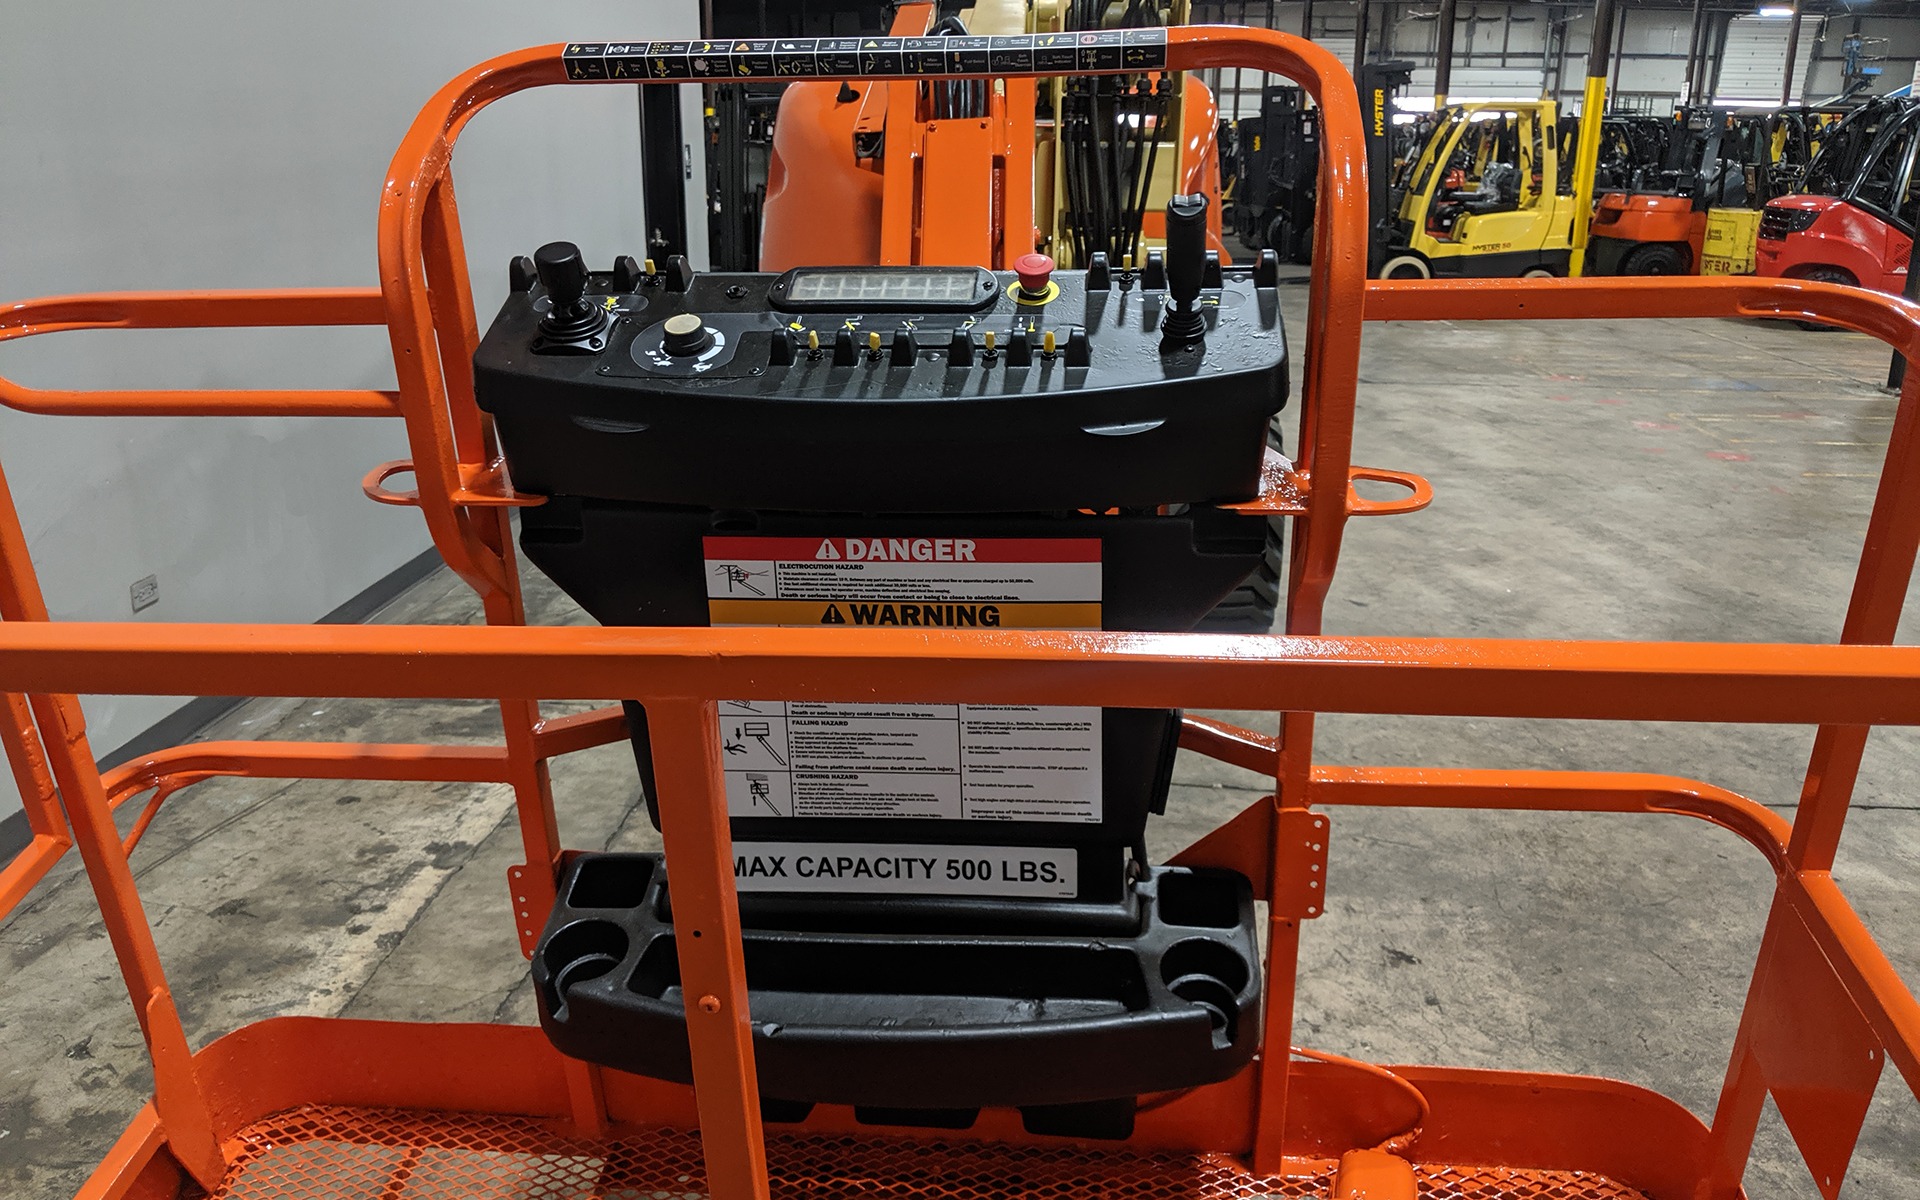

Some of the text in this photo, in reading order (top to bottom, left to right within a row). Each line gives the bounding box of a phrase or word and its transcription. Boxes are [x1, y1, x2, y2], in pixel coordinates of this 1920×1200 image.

[1374, 88, 1384, 136] HYSTER
[845, 538, 976, 561] DANGER
[849, 604, 1000, 627] WARNING
[733, 856, 1065, 883] MAX CAPACITY 500 LBS.
